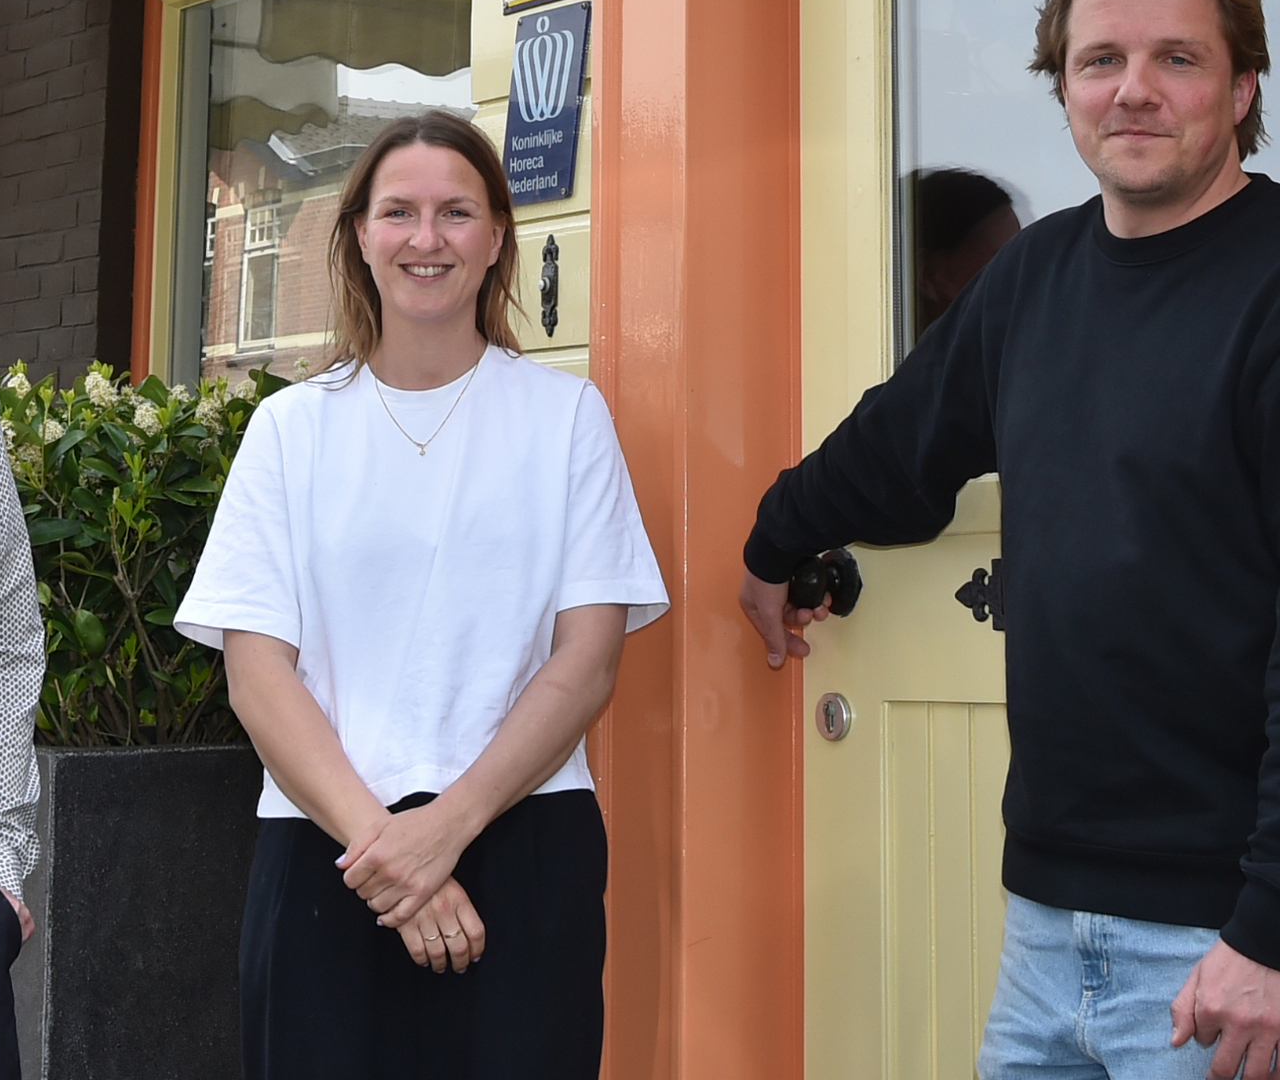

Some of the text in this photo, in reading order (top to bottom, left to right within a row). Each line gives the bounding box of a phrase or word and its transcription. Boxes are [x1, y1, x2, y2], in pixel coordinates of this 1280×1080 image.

[511, 128, 564, 152] Koninklijke
[509, 155, 544, 174] Horeca
[507, 171, 559, 194] Nederland
